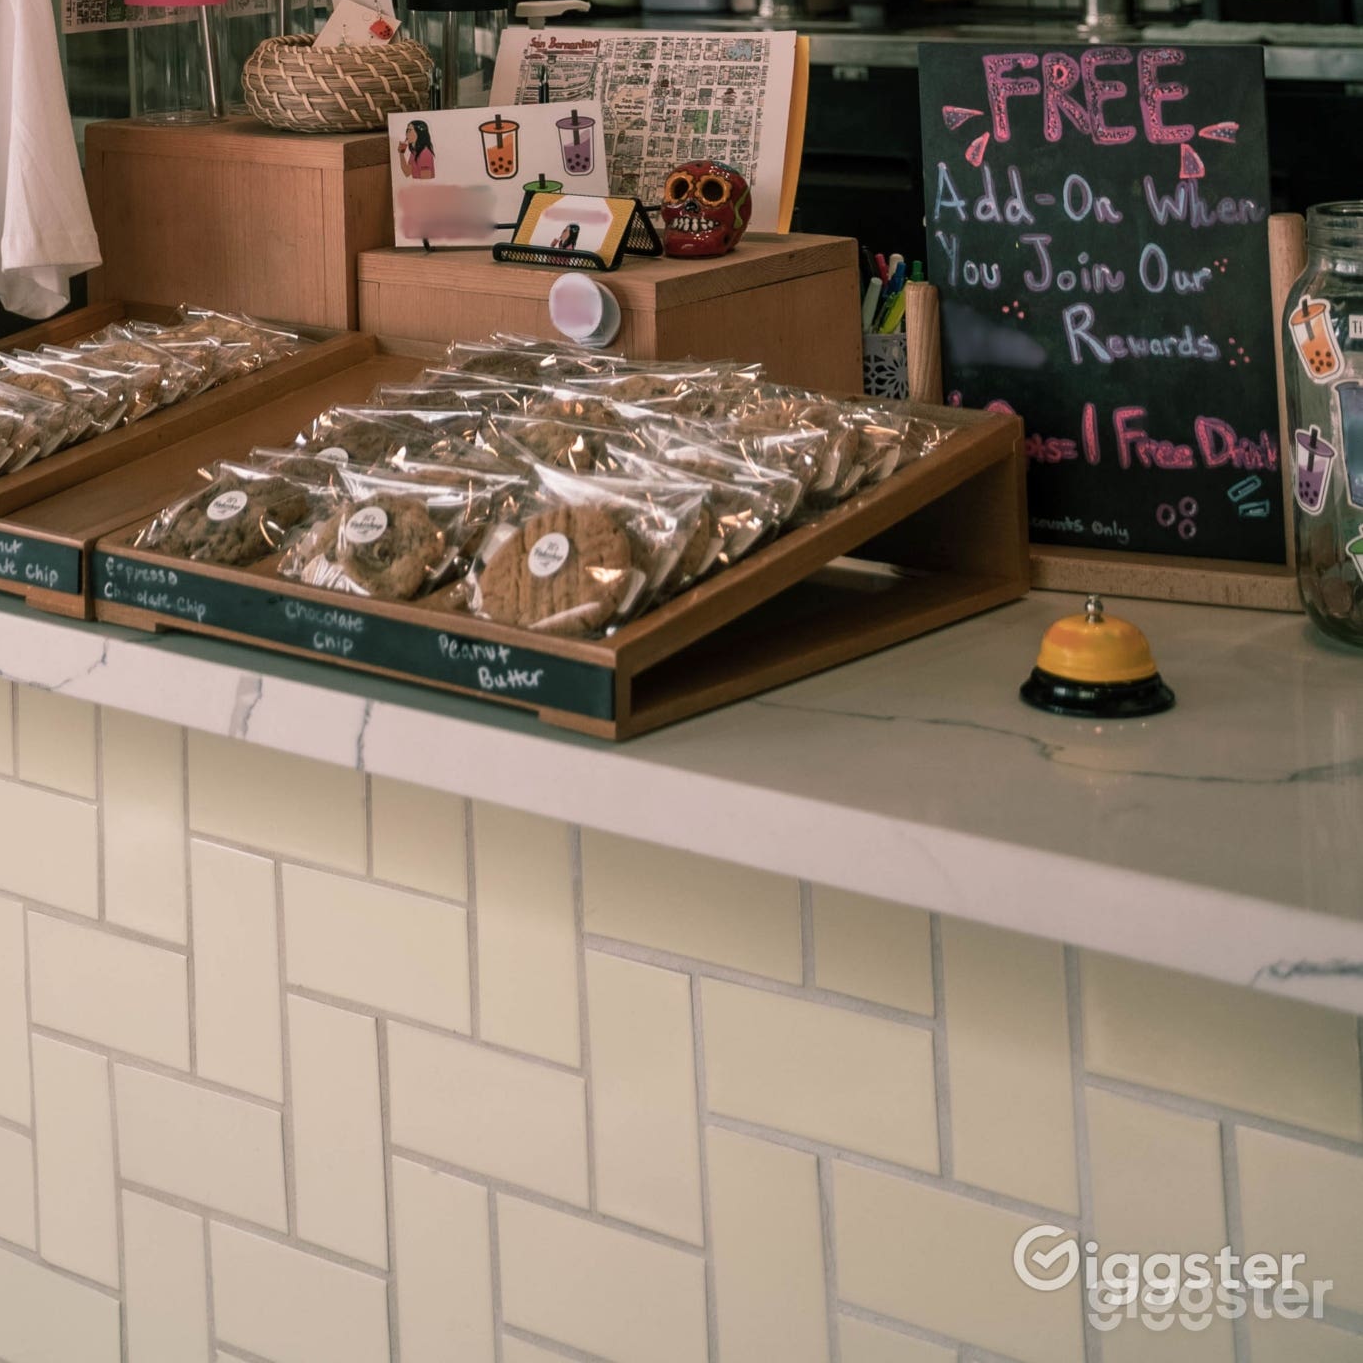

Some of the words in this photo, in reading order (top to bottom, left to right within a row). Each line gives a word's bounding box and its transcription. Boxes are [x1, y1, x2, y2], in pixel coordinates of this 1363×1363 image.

[530, 36, 545, 49] San
[548, 36, 600, 50] Bernardino
[982, 47, 1195, 146] FREE
[933, 162, 1122, 228] Add-On
[1144, 176, 1266, 228] When
[934, 230, 1001, 289] You
[1020, 234, 1125, 293] Join
[1138, 242, 1213, 294] Our
[1061, 303, 1221, 364] Rewards
[1113, 406, 1195, 470] Free
[1194, 415, 1278, 471] Drink
[1091, 519, 1130, 544] Only
[25, 563, 59, 588] Chip
[177, 596, 206, 622] Chip
[285, 600, 365, 633] Chocolate
[313, 632, 354, 656] Chip
[438, 633, 511, 665] Peanut
[478, 665, 544, 690] Butter
